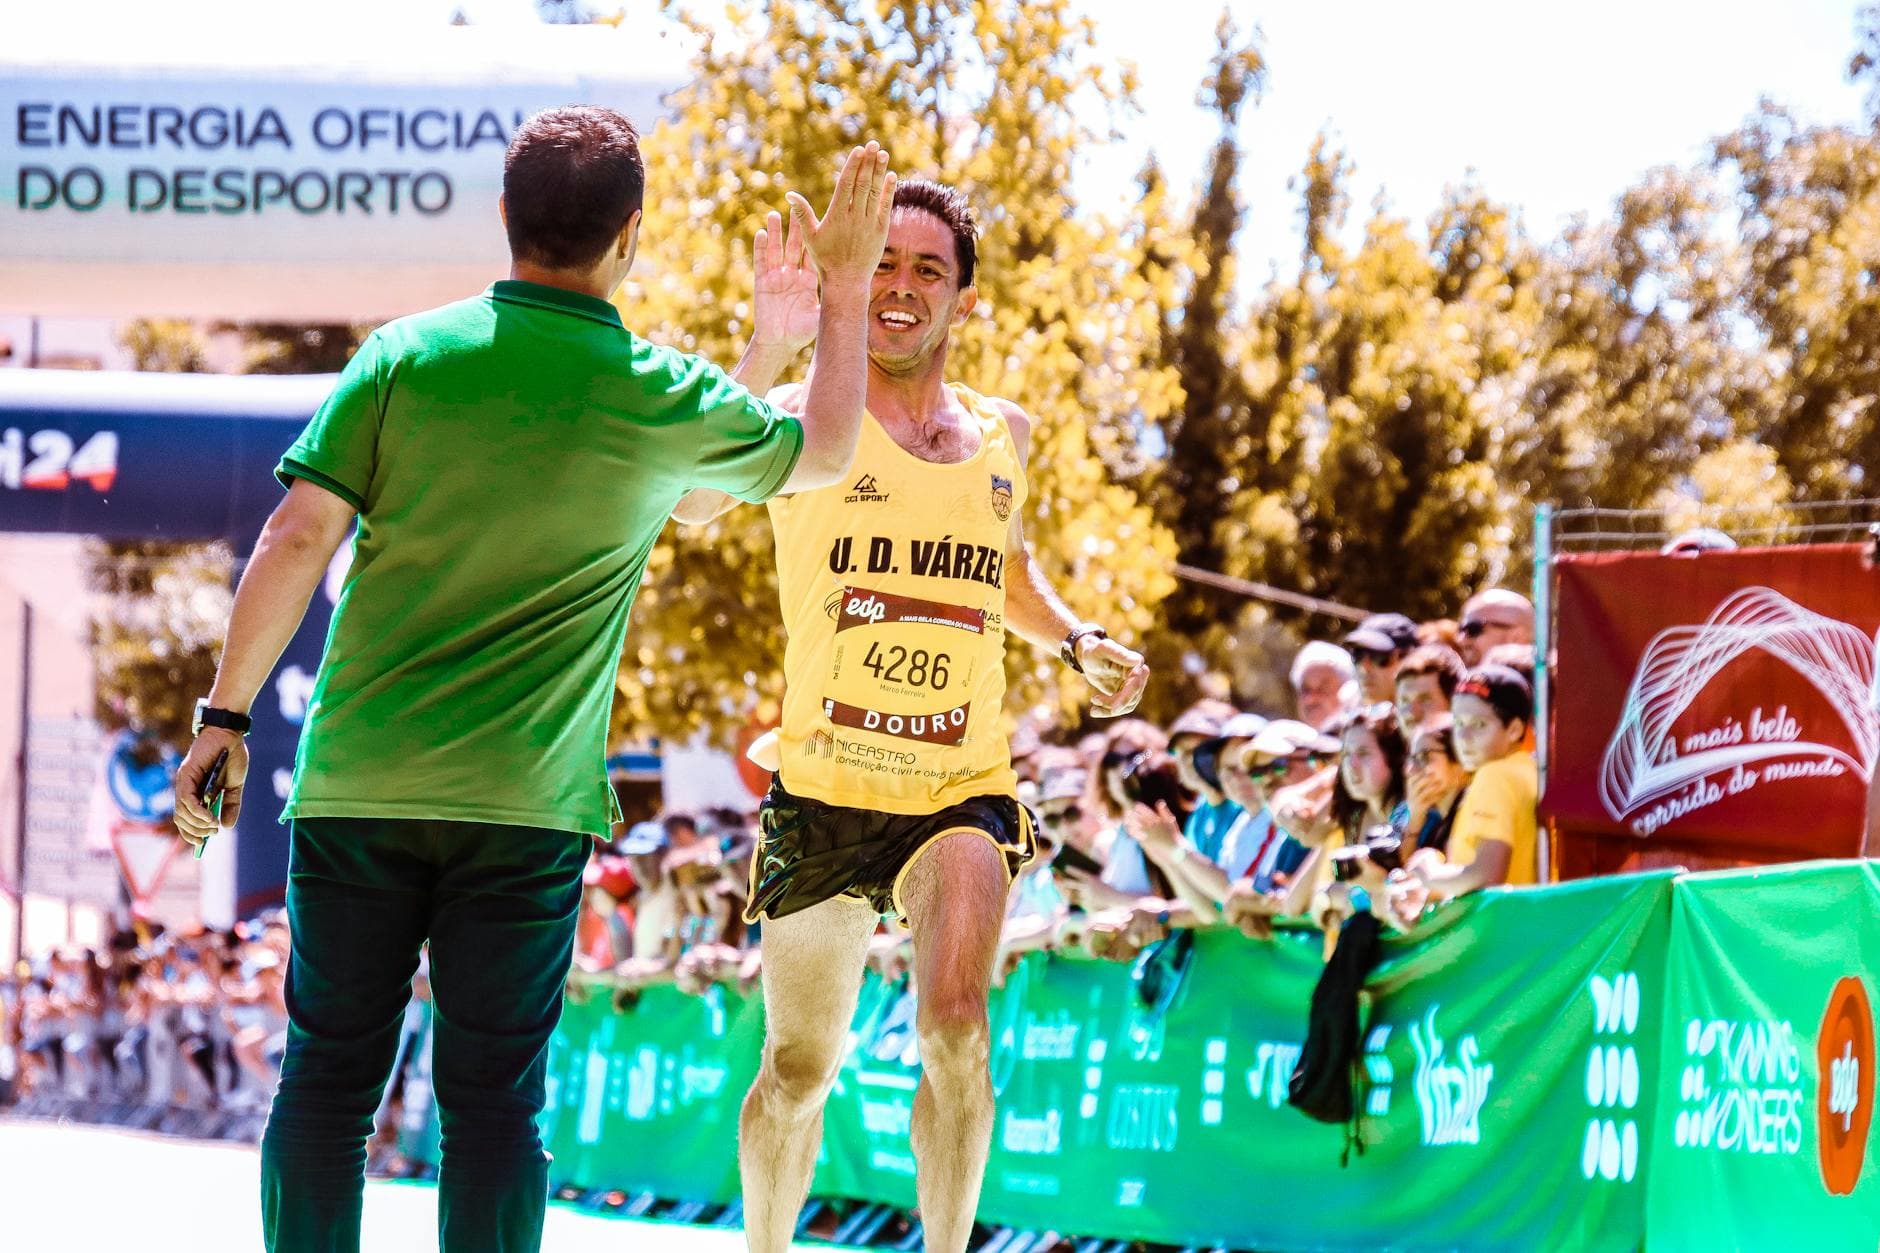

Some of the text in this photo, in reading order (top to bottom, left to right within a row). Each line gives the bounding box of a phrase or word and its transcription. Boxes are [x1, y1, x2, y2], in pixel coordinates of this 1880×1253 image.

[17, 103, 523, 150] ENERGIA OFICIA
[18, 165, 453, 214] DO DESPORTO
[844, 493, 890, 503] CCI SPORT
[829, 536, 857, 575] U.
[867, 536, 899, 574] D.
[845, 595, 886, 625] edp
[862, 641, 951, 691] 4286
[880, 684, 900, 694] Marco
[863, 707, 965, 736] DOURO
[1685, 716, 1743, 752] mais
[1750, 705, 1802, 742] bela
[835, 755, 888, 773] construção
[891, 766, 912, 776] civil
[836, 738, 916, 765] NICEASTRO
[1633, 757, 1845, 838] corrida do mundo
